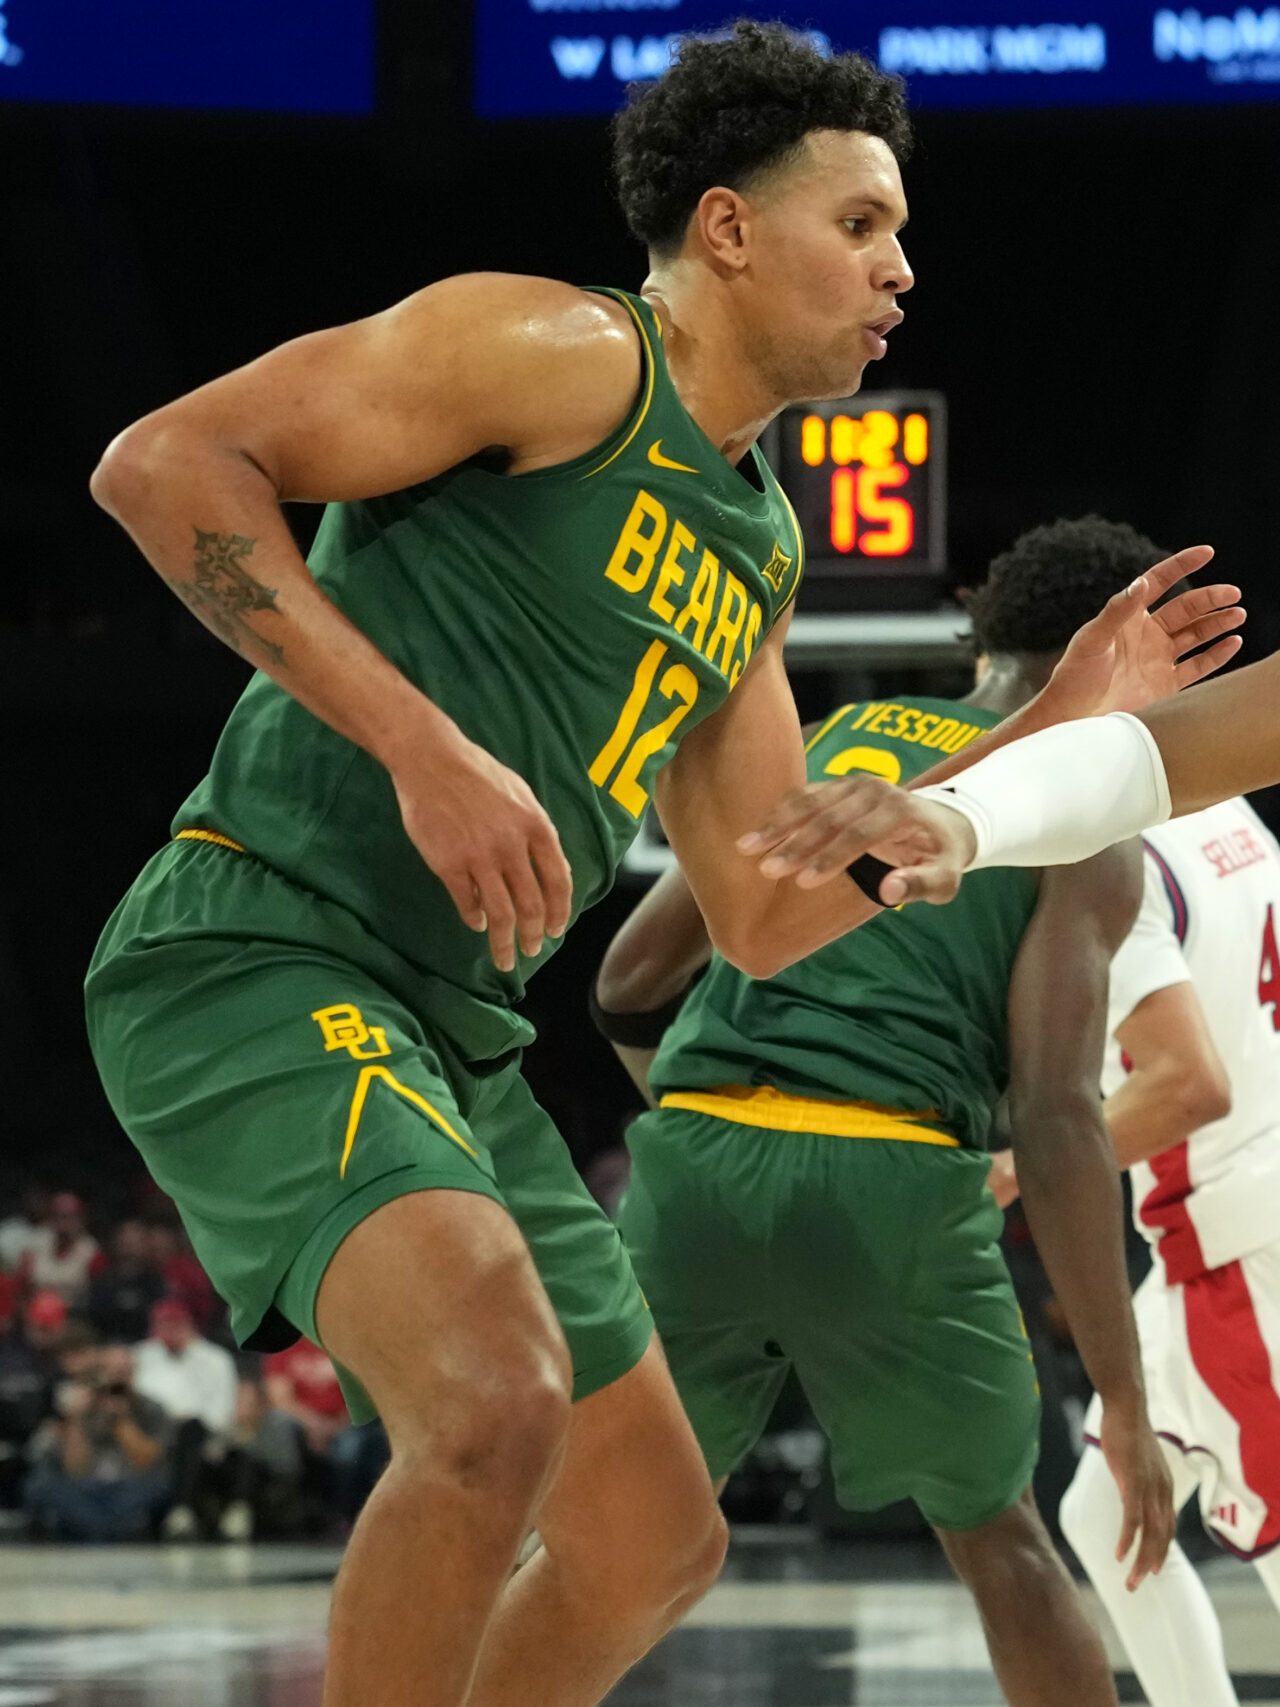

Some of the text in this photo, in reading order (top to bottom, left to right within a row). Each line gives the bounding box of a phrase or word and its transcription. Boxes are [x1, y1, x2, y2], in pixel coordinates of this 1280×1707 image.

[831, 463, 914, 556] 15
[604, 490, 762, 693] BEARS
[588, 639, 699, 819] 12
[851, 702, 990, 754] YESSOU
[311, 1003, 392, 1060] BU
